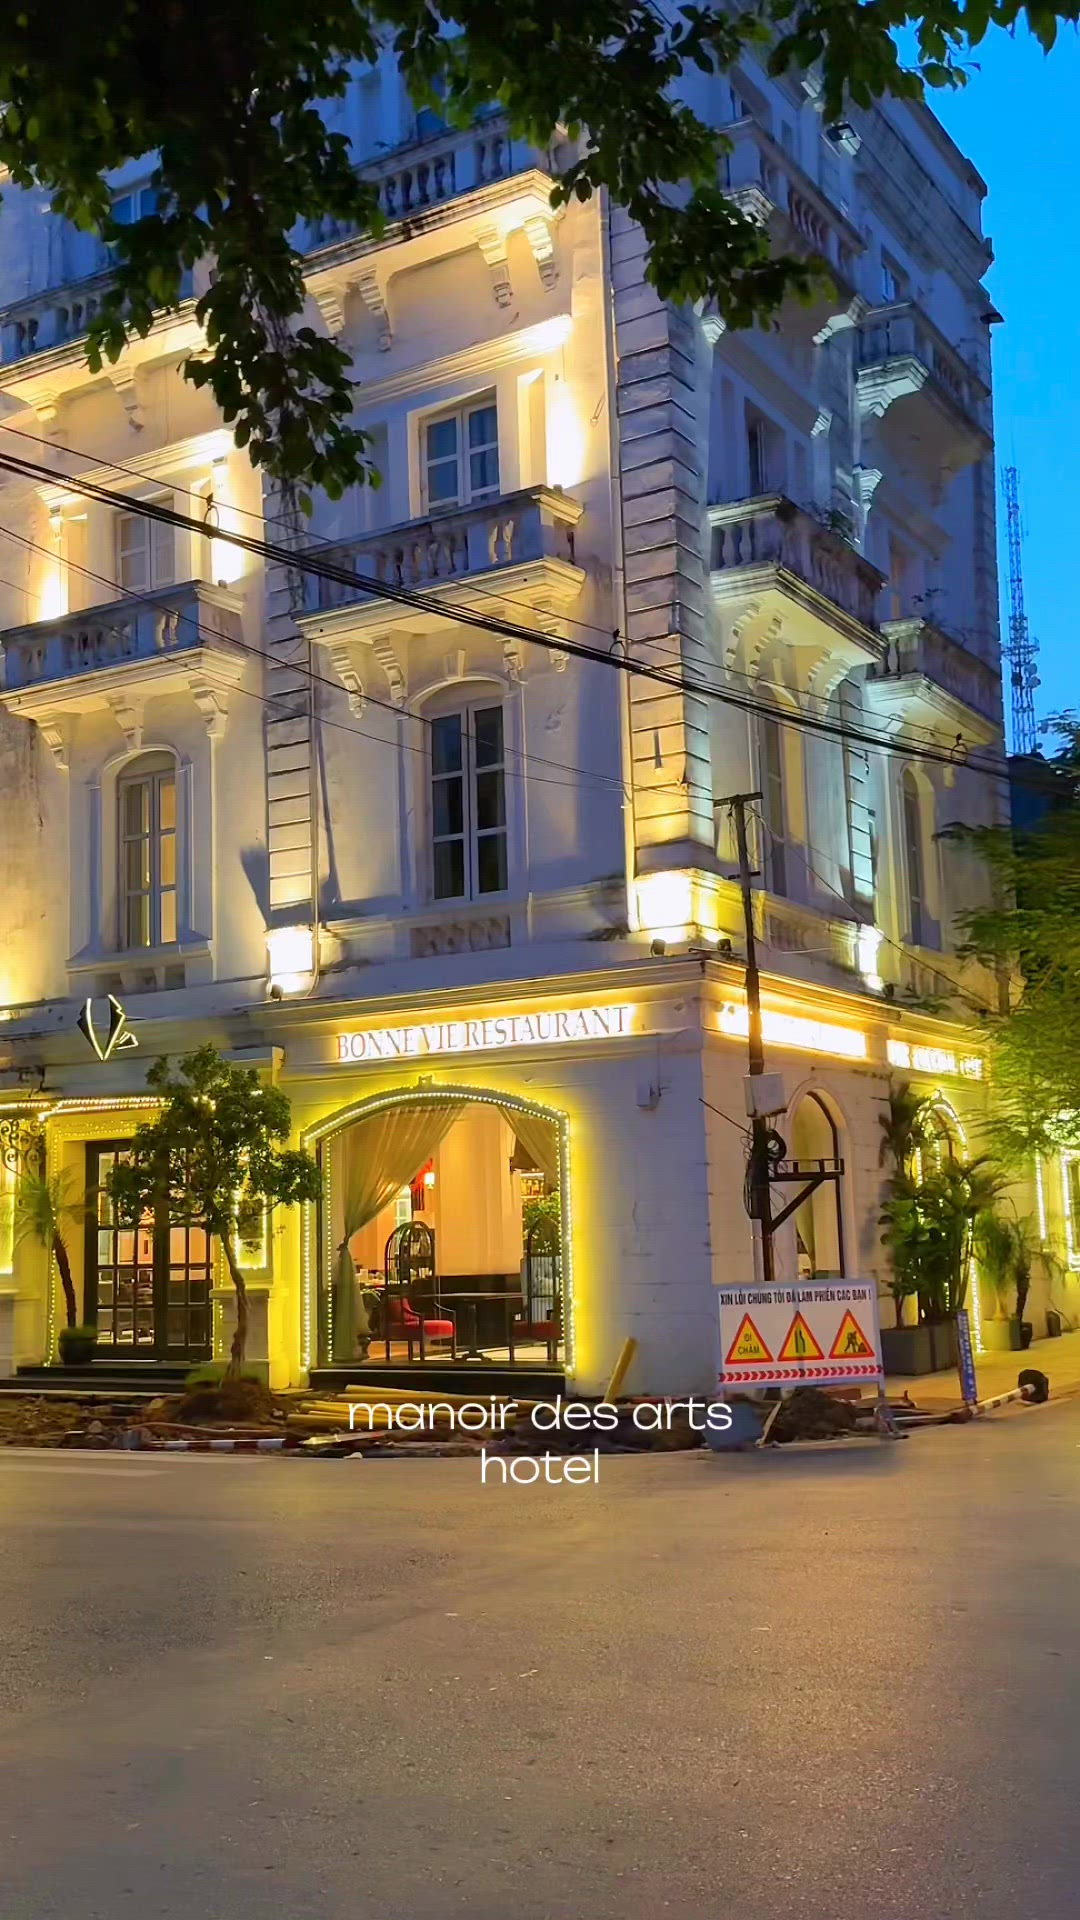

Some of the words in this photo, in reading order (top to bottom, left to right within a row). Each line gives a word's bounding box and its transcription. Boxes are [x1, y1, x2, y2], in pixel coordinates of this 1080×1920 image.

[336, 1028, 415, 1060] BONNE
[421, 1024, 458, 1050] VIE
[464, 1006, 629, 1047] RESTAURANT
[720, 1293, 733, 1305] XIN
